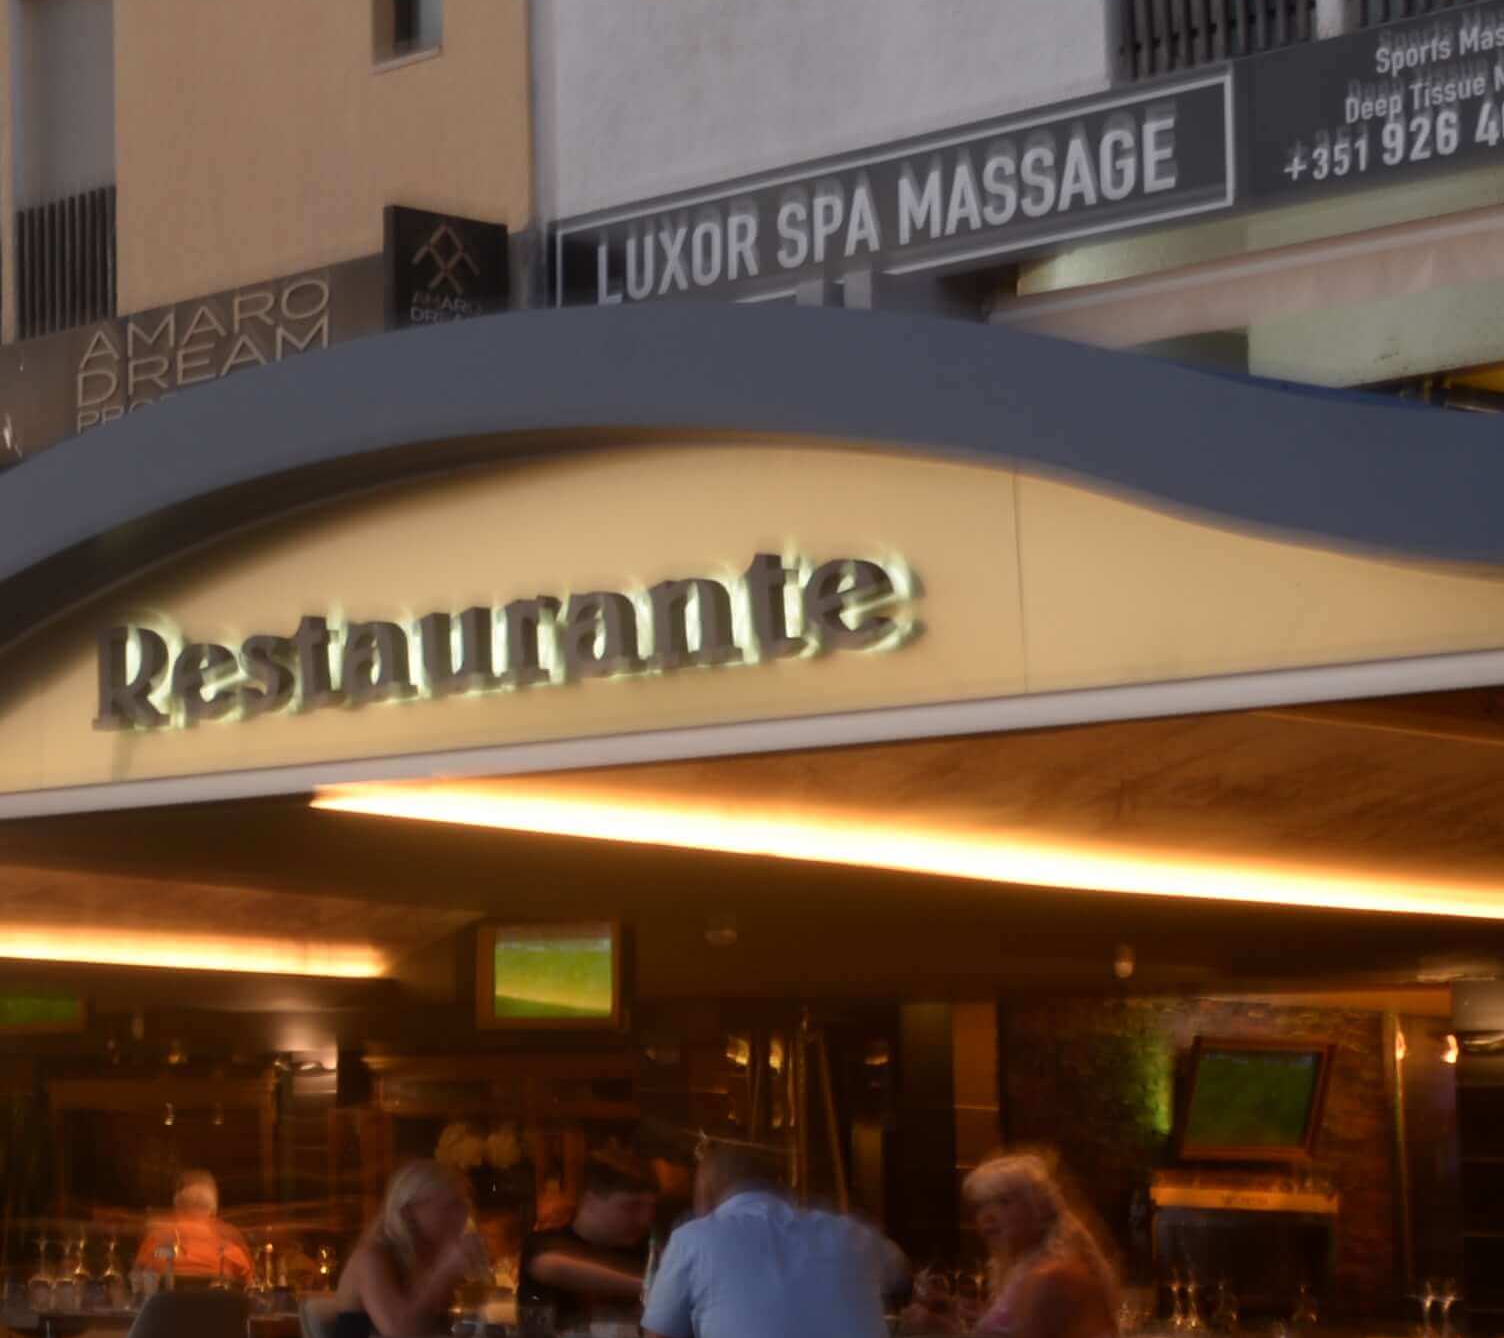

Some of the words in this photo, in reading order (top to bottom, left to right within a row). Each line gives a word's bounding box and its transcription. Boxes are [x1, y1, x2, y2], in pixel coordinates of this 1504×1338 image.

[1345, 94, 1403, 124] Deep
[1409, 75, 1486, 110] Tissue
[1375, 38, 1452, 78] Sports
[1284, 136, 1369, 181] +351
[1381, 111, 1459, 166] 926
[596, 214, 759, 304] LUXOR
[776, 185, 881, 269] SPA
[897, 116, 1177, 246] MASSAGE
[77, 315, 330, 408] DREAM
[79, 278, 329, 369] AMARO
[92, 549, 922, 732] Restaurante
